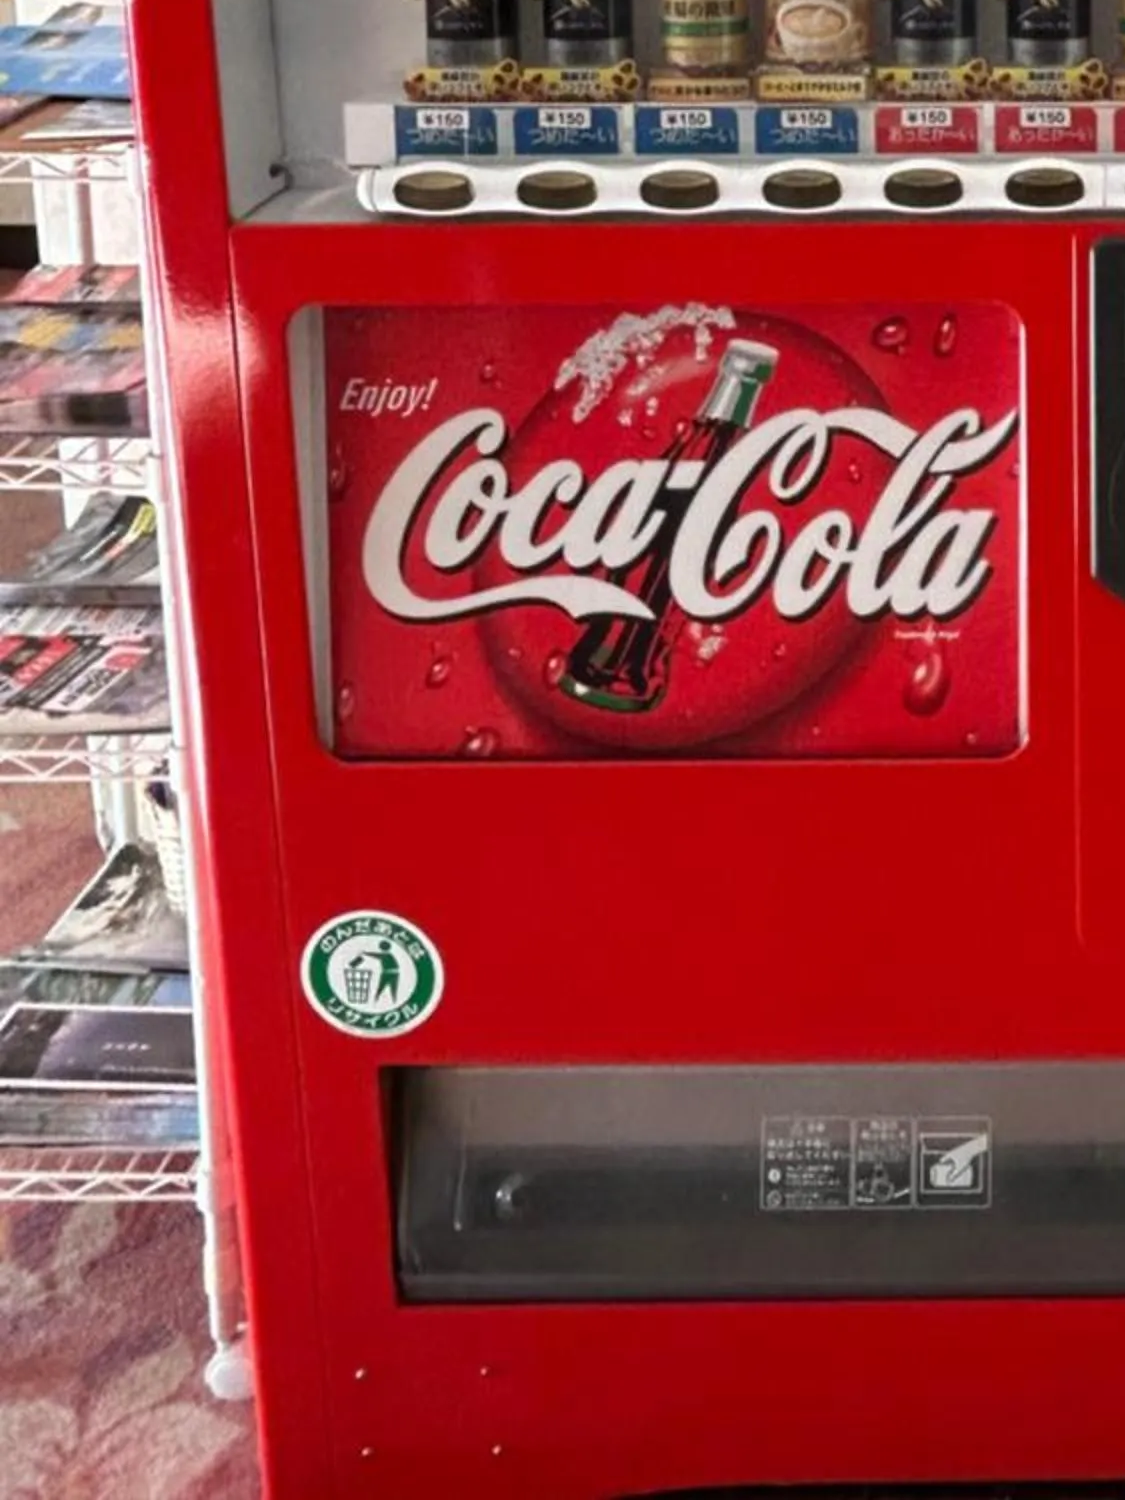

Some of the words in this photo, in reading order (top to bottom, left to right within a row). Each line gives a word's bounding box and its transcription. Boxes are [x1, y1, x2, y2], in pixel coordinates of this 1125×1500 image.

[339, 377, 439, 418] Enjoy!
[361, 406, 1020, 621] Coca-Cola
[326, 997, 419, 1028] リサイクル
